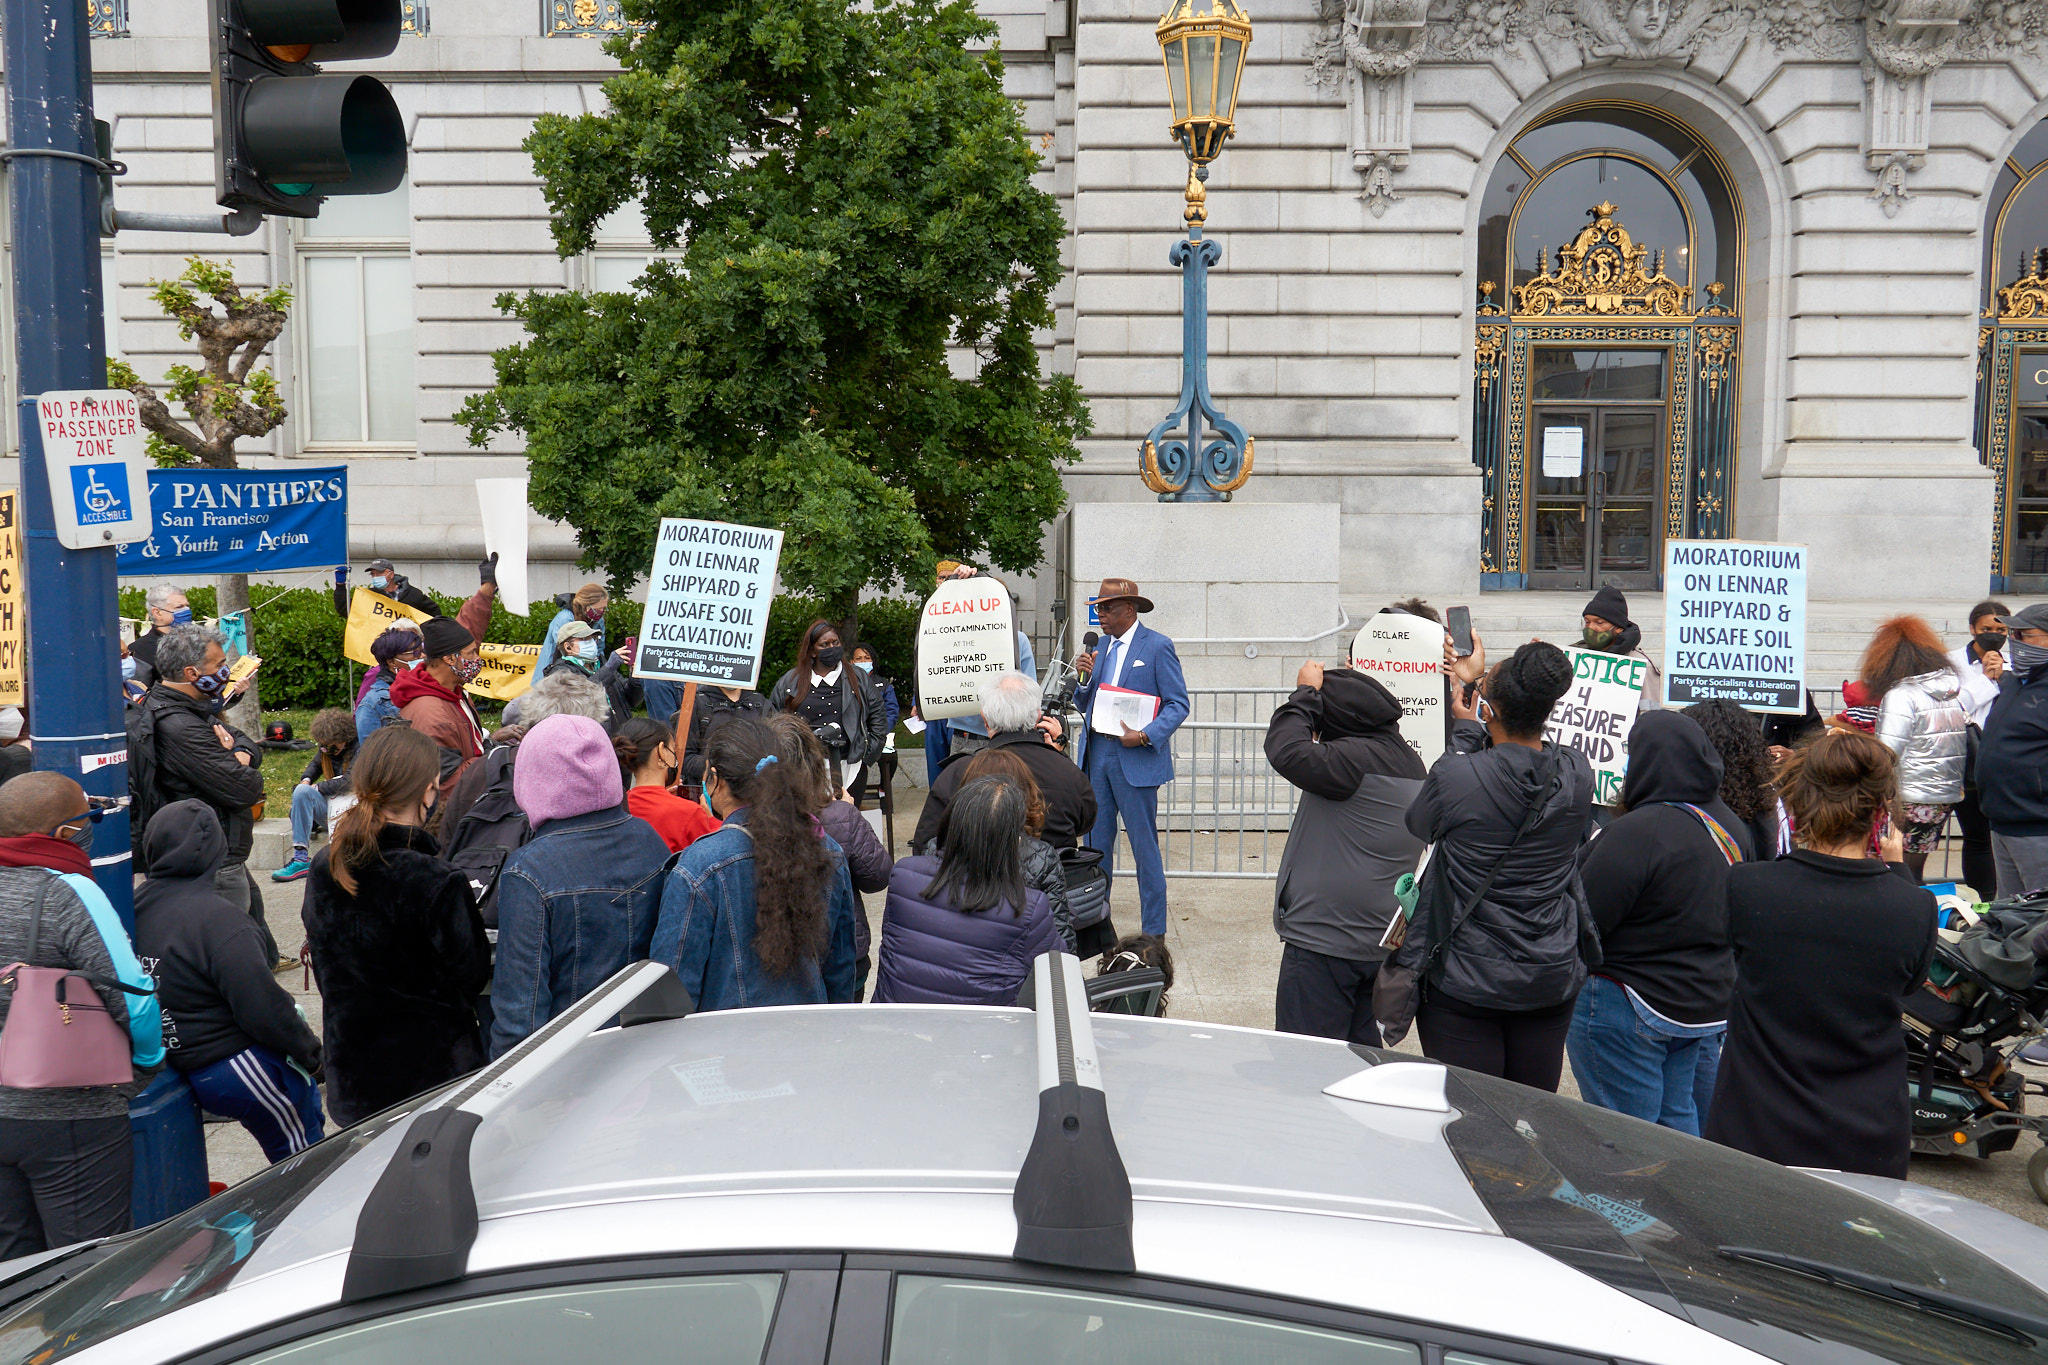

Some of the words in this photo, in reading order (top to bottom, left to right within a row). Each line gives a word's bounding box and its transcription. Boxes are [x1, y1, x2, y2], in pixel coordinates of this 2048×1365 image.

[42, 402, 63, 418] NO
[70, 400, 136, 418] PARKING
[48, 418, 136, 438] PASSENGER
[76, 439, 115, 457] ZONE
[172, 478, 342, 508] PANTHERS
[82, 509, 128, 524] ACCESSIBLE
[161, 512, 194, 527] San
[202, 511, 269, 526] Francisco
[142, 536, 160, 558] &
[171, 535, 218, 556] Youth
[229, 537, 244, 550] in
[256, 530, 309, 551] Action
[663, 525, 774, 550] MORATORIUM
[669, 550, 692, 567] ON
[696, 551, 759, 574] LENNAR
[1673, 548, 1800, 570] MORATORIUM
[662, 574, 740, 596] SHIPYARD
[745, 582, 758, 599] &
[1684, 574, 1711, 592] ON
[1718, 574, 1788, 596] LENNAR
[372, 602, 412, 623] Bay
[657, 600, 716, 621] UNSAFE
[719, 605, 754, 626] SOIL
[928, 599, 974, 616] CLEAN
[980, 598, 1000, 612] UP
[1680, 600, 1771, 620] SHIPYARD
[1778, 604, 1791, 622] &
[650, 623, 753, 650] EXCAVATION!
[924, 628, 936, 636] ALL
[939, 622, 1007, 633] CONTAMINATION
[1372, 631, 1410, 639] DECLARE
[1680, 627, 1748, 646] UNSAFE
[1754, 630, 1792, 649] SOIL
[502, 644, 542, 656] Poin
[645, 648, 664, 657] Party
[675, 650, 706, 660] Socialism
[714, 654, 750, 665] Liberation
[943, 654, 987, 663] SHIPYARD
[658, 658, 733, 678] PSLweb.org
[928, 665, 981, 675] SUPERFUND
[984, 663, 1004, 672] SITE
[1356, 658, 1436, 673] MORATORIUM
[1564, 650, 1646, 691] USTICE
[1676, 651, 1794, 674] EXCAVATION!
[1674, 677, 1694, 686] Party
[1709, 679, 1747, 687] Socialism
[1756, 680, 1795, 690] Liberation
[925, 695, 973, 705] TREASURE
[1396, 697, 1438, 706] HIPYARD
[1578, 686, 1592, 706] 4
[1691, 686, 1778, 705] PSLweb.org
[98, 752, 127, 765] MISSI
[1915, 1109, 1947, 1119] C300
